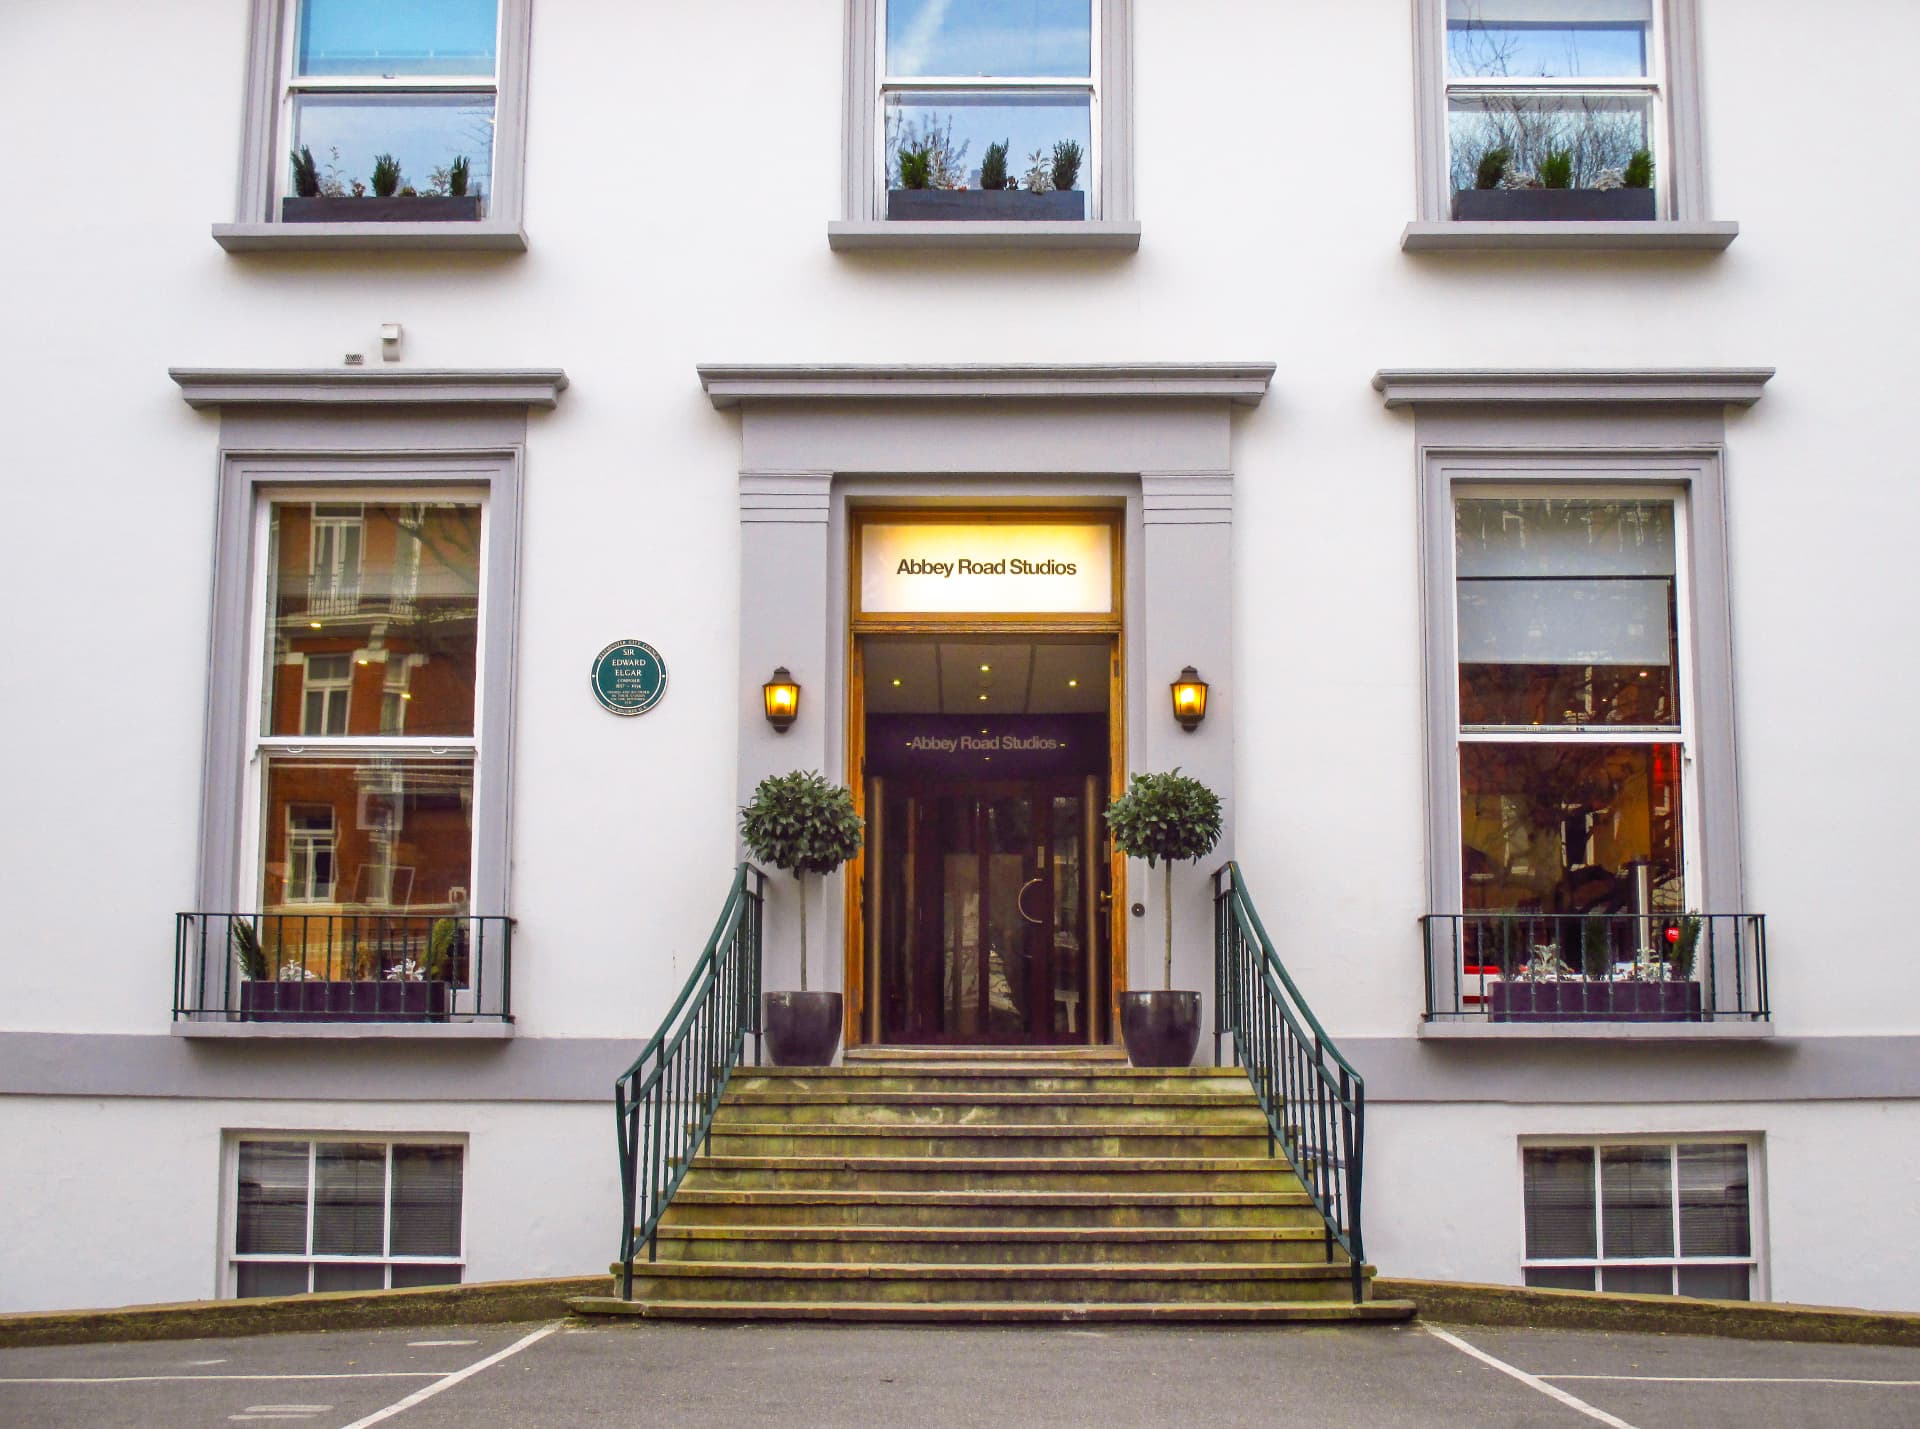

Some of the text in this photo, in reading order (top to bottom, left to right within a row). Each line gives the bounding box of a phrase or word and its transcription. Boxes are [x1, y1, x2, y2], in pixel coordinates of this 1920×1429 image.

[896, 558, 1077, 579] Abbey Road Studios
[623, 648, 635, 656] SIR
[615, 669, 642, 677] ELGAR
[911, 736, 1057, 753] Abbey Road Studios
